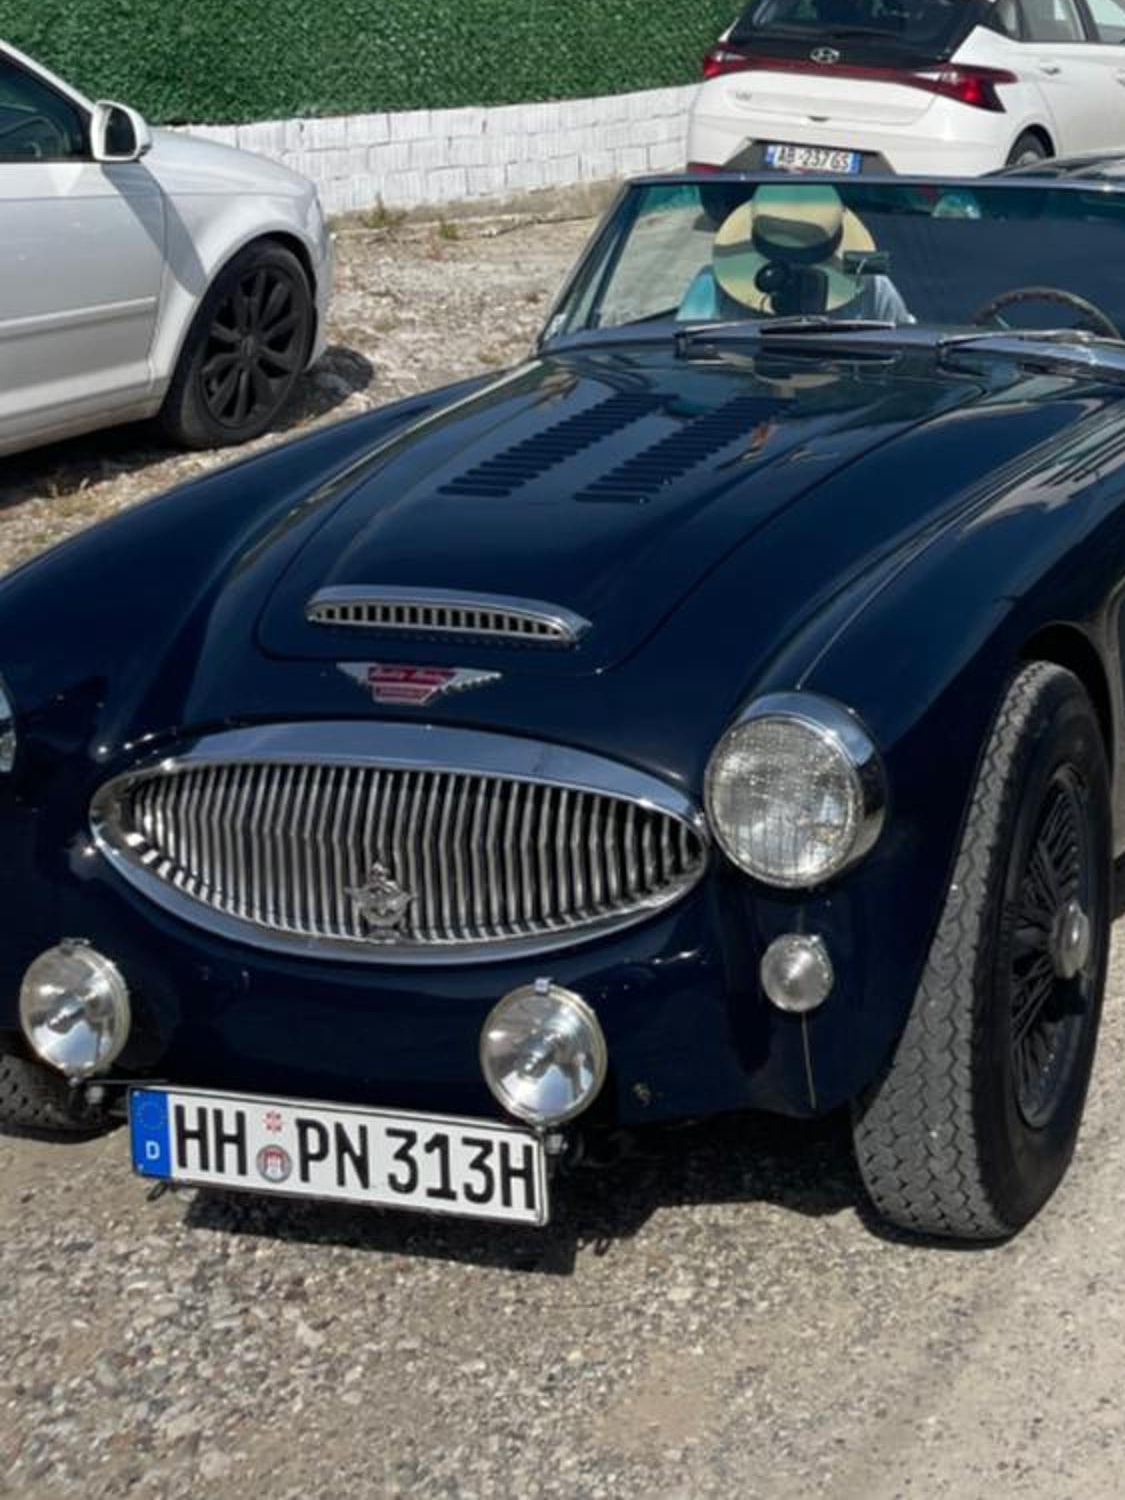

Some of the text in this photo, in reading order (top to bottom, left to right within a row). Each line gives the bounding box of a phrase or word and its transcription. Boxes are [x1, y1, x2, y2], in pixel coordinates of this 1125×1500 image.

[145, 1141, 160, 1160] D
[174, 1104, 537, 1210] HH PN 313H
